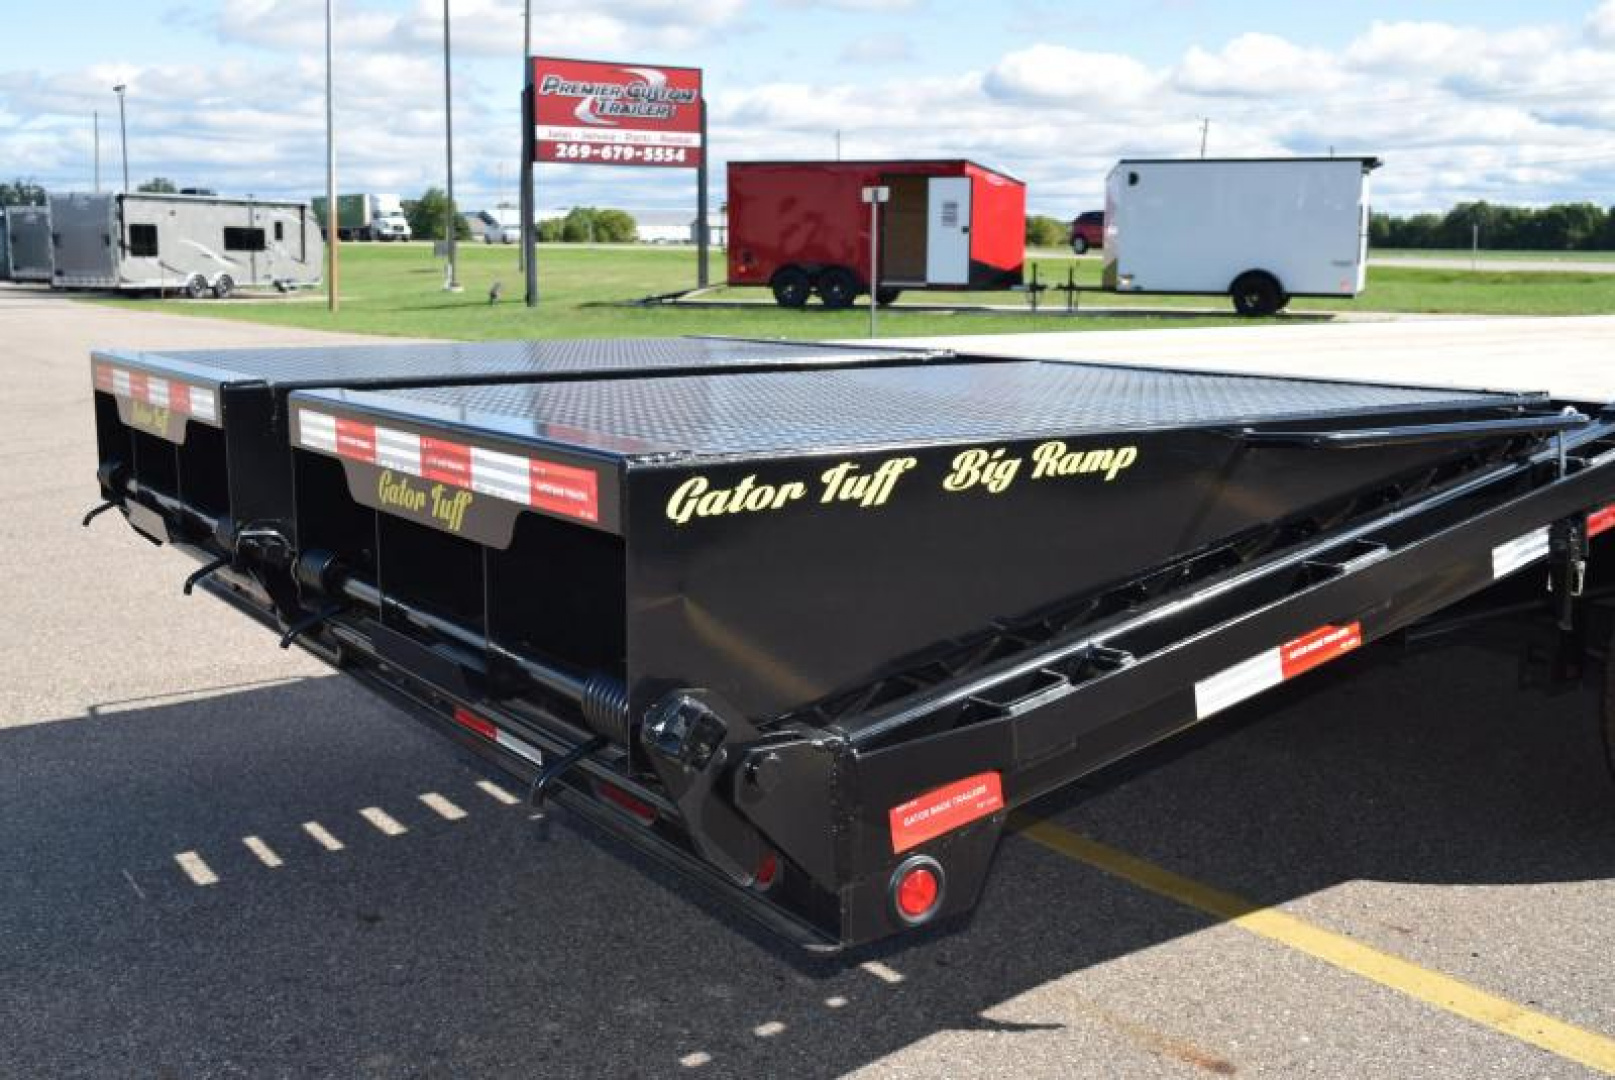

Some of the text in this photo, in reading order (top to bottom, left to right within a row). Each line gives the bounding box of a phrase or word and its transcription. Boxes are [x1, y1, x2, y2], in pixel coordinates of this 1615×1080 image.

[555, 143, 686, 163] 269-679-5554
[378, 470, 473, 532] Gator Tuff
[665, 440, 1139, 525] Gator Tuff Big Ramp
